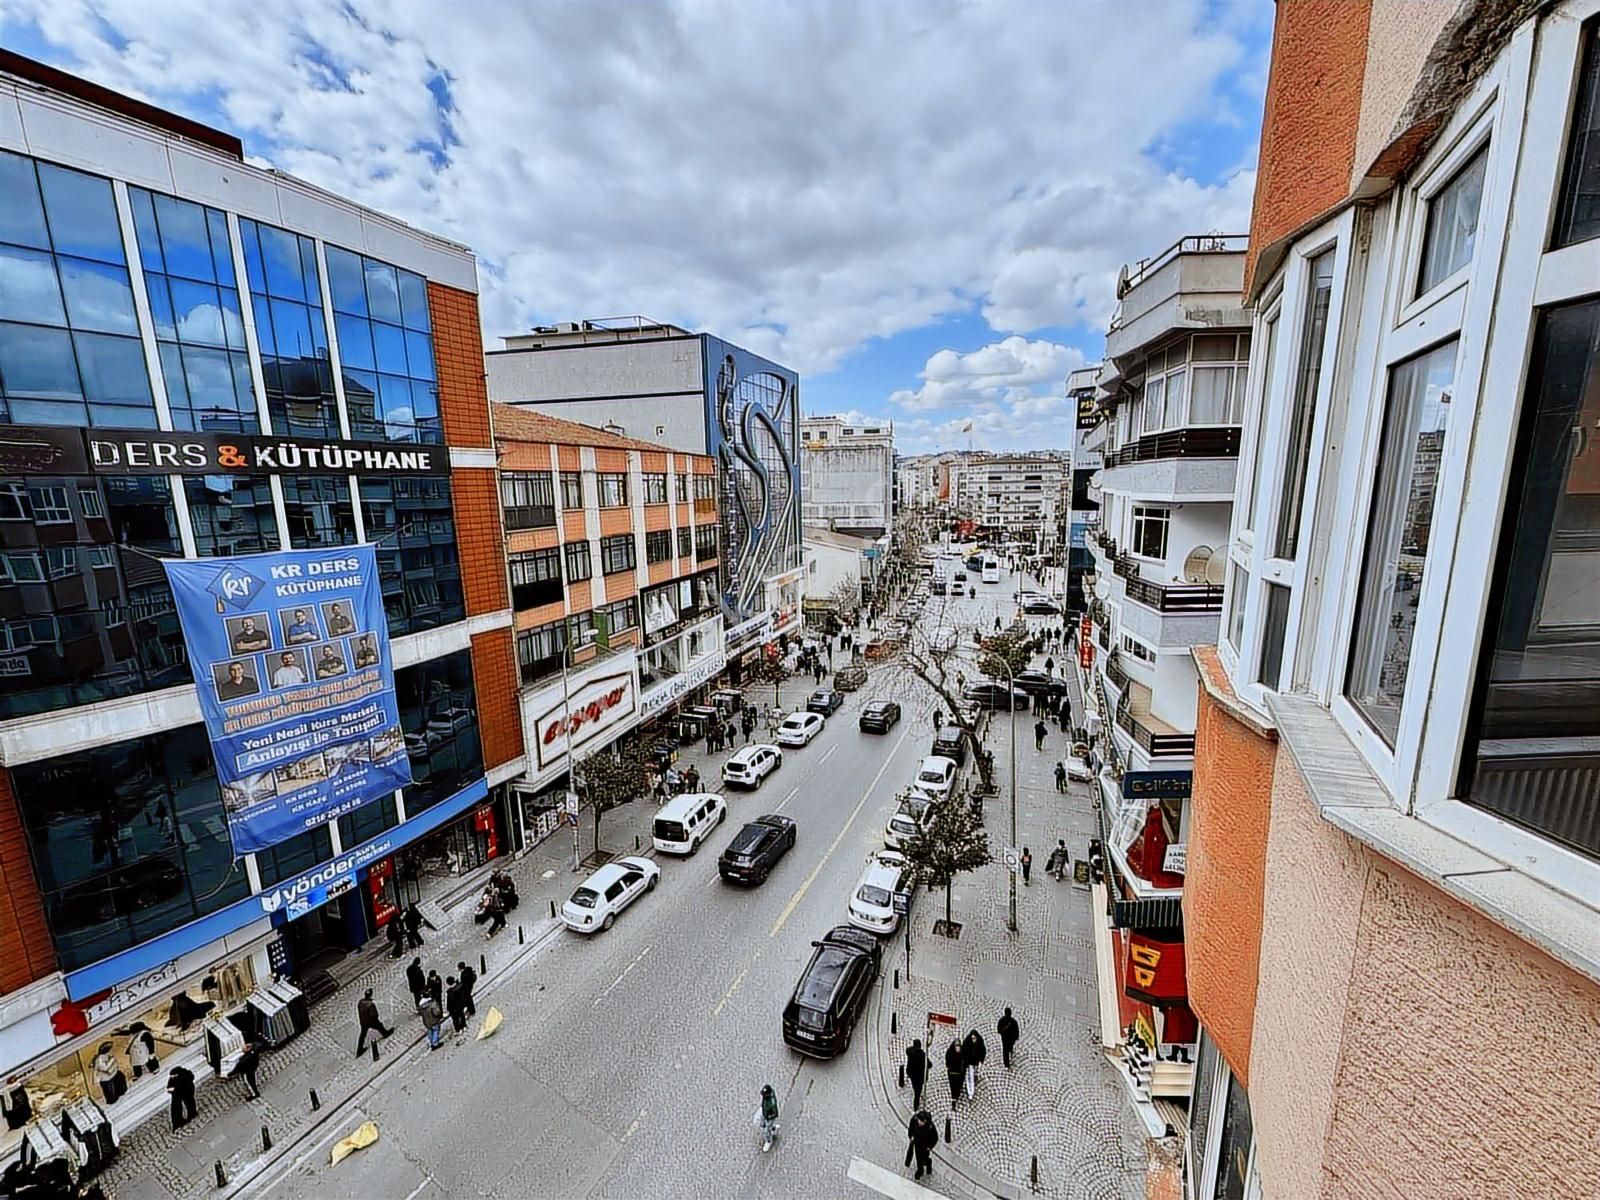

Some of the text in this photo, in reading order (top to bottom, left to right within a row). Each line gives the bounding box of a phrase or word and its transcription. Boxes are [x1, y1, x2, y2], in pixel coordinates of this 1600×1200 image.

[90, 439, 432, 470] DERS & KÜTÜPHANE
[270, 558, 360, 579] KR DERS
[275, 574, 363, 597] KÜTÜPHANE
[243, 702, 378, 750] Yeni Nesil Kurs Merkezi
[282, 855, 356, 904] yönder
